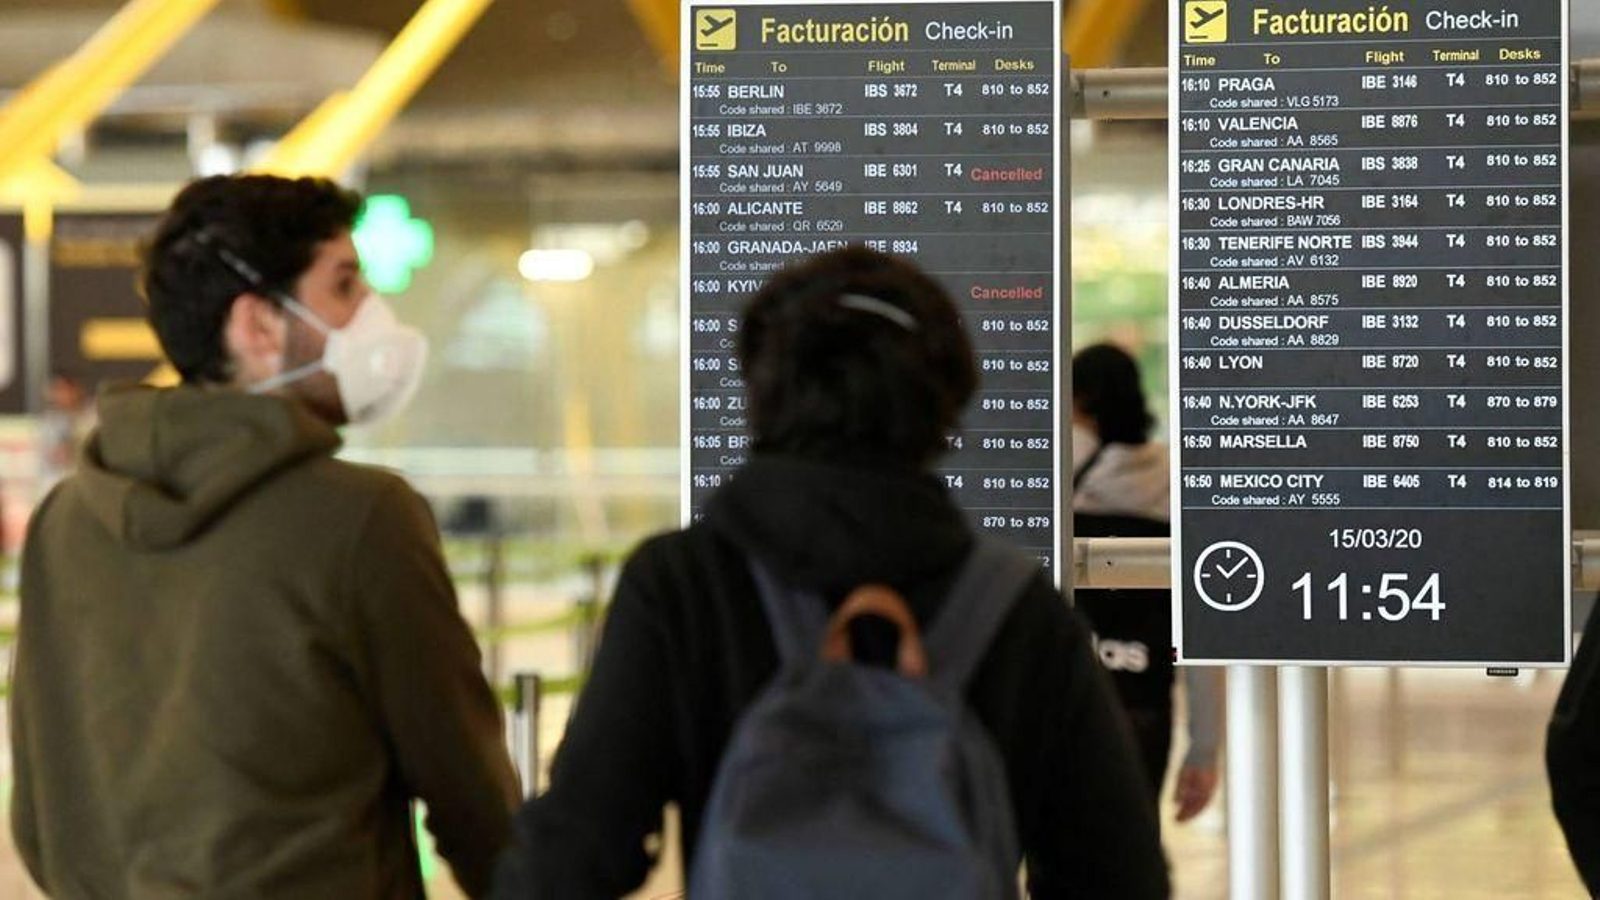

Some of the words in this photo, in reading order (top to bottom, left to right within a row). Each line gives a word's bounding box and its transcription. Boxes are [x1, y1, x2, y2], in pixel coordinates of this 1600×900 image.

[1254, 6, 1408, 34] Facturación
[1426, 10, 1518, 30] Check-in
[762, 17, 908, 43] Facturación
[926, 21, 1012, 40] Check-in
[1184, 55, 1215, 66] Time
[1264, 54, 1280, 64] To
[1366, 51, 1403, 65] Flight
[1433, 50, 1479, 61] Terminal
[1500, 48, 1541, 59] Desks
[695, 62, 725, 73] Time
[771, 62, 787, 72] To
[869, 61, 904, 73] Flight
[932, 60, 975, 70] Terminal
[995, 59, 1034, 70] Desks
[1182, 78, 1210, 91] 16:10
[1219, 77, 1275, 91] PRAGA
[1362, 75, 1386, 89] IBE
[1393, 75, 1417, 88] 3146
[1446, 73, 1464, 86] T4
[1486, 74, 1508, 85] 810
[1515, 75, 1529, 84] to
[1534, 73, 1556, 84] 852
[693, 85, 720, 98] 15:55
[728, 85, 784, 98] BERLIN
[865, 84, 887, 97] IBS
[894, 84, 917, 97] 3672
[944, 84, 962, 96] T4
[982, 84, 1003, 95] 810
[1010, 85, 1023, 94] to
[1027, 84, 1048, 94] 852
[720, 104, 746, 114] Code
[749, 104, 784, 114] shared
[793, 103, 811, 114] IBE
[815, 104, 842, 114] 3672
[1210, 98, 1238, 108] Code
[1241, 97, 1277, 107] shared
[1287, 96, 1310, 107] VLG
[1313, 97, 1338, 107] 5173
[1182, 118, 1210, 131] 16:10
[1218, 117, 1298, 130] VALENCIA
[1362, 115, 1385, 128] IBE
[1392, 115, 1417, 127] 8876
[1446, 114, 1464, 126] T4
[1487, 115, 1509, 126] 810
[1515, 114, 1528, 125] to
[1533, 114, 1556, 125] 852
[693, 125, 720, 137] 15:55
[728, 124, 766, 137] IBIZA
[865, 123, 886, 136] IBS
[893, 123, 917, 135] 3804
[944, 123, 962, 135] T4
[983, 124, 1004, 134] 810
[1010, 124, 1022, 134] to
[1027, 124, 1048, 134] 852
[1182, 159, 1210, 172] 16:25
[1218, 159, 1264, 172] GRAN
[1269, 158, 1339, 171] CANARIA
[1362, 157, 1385, 170] IBS
[1392, 156, 1417, 169] 3838
[1446, 156, 1464, 168] T4
[1487, 154, 1509, 165] 810
[1514, 155, 1528, 165] to
[1533, 154, 1556, 166] 852
[693, 165, 720, 177] 15:55
[728, 165, 758, 178] SAN
[763, 165, 803, 178] JUAN
[865, 164, 886, 177] IBE
[893, 164, 916, 176] 6301
[945, 164, 962, 176] T4
[971, 168, 1042, 180] Cancelled
[720, 182, 746, 192] Code
[749, 183, 784, 192] shared
[793, 181, 808, 191] AY
[815, 181, 842, 192] 5649
[693, 203, 720, 215] 16:00
[728, 202, 803, 214] ALICANTE
[865, 201, 886, 214] IBE
[893, 201, 917, 214] 8862
[945, 201, 962, 213] T4
[983, 203, 1004, 212] 810
[1010, 203, 1022, 212] to
[1027, 202, 1048, 212] 852
[1182, 198, 1210, 210] 16:30
[1219, 196, 1324, 210] LONDRES-HR
[1362, 195, 1385, 208] IBE
[1392, 195, 1418, 207] 3164
[1446, 194, 1465, 207] T4
[1487, 195, 1509, 206] 810
[1515, 195, 1528, 206] to
[1533, 195, 1556, 205] 852
[1210, 217, 1238, 227] Code
[1241, 217, 1277, 226] shared
[1287, 215, 1313, 226] BAW
[1316, 215, 1340, 225] 7056
[693, 241, 720, 253] 16:00
[893, 240, 917, 252] 8934
[1182, 237, 1210, 250] 16:30
[1219, 236, 1294, 249] TENERIFE
[1298, 235, 1352, 249] NORTE
[1362, 235, 1385, 248] IBS
[1392, 235, 1418, 247] 3944
[1446, 234, 1465, 247] T4
[1487, 235, 1509, 246] 810
[1515, 236, 1528, 246] to
[1533, 235, 1556, 245] 852
[694, 280, 720, 292] 16:00
[971, 286, 1042, 299] Cancelled
[1183, 396, 1211, 408] 16:40
[1220, 395, 1316, 408] N.YORK-JFK
[1363, 395, 1386, 408] IBE
[1393, 395, 1419, 408] 6253
[1447, 395, 1466, 407] T4
[1487, 396, 1510, 407] 870
[1516, 397, 1529, 407] to
[1534, 396, 1557, 407] 879
[1184, 435, 1211, 448] 16:50
[1220, 435, 1307, 448] MARSELLA
[1363, 435, 1386, 448] IBE
[1393, 435, 1419, 447] 8750
[1447, 435, 1466, 447] T4
[1488, 437, 1511, 447] 810
[1516, 437, 1530, 447] to
[1534, 437, 1557, 447] 852
[1184, 475, 1212, 487] 16:50
[1221, 474, 1282, 488] MEXICO
[1287, 475, 1323, 487] CITY
[1364, 475, 1387, 487] IBE
[1393, 475, 1420, 487] 6405
[1448, 475, 1466, 487] T4
[1488, 477, 1511, 488] 814
[1516, 477, 1530, 487] to
[1534, 476, 1558, 487] 819
[1212, 495, 1240, 505] Code
[1242, 495, 1279, 505] shared
[1289, 494, 1305, 504] AY
[1312, 494, 1340, 505] 5555
[984, 517, 1005, 527] 870
[1010, 518, 1023, 527] to
[1028, 517, 1049, 527] 879
[1330, 529, 1422, 548] 15/03/20
[1292, 573, 1445, 620] 11:54
